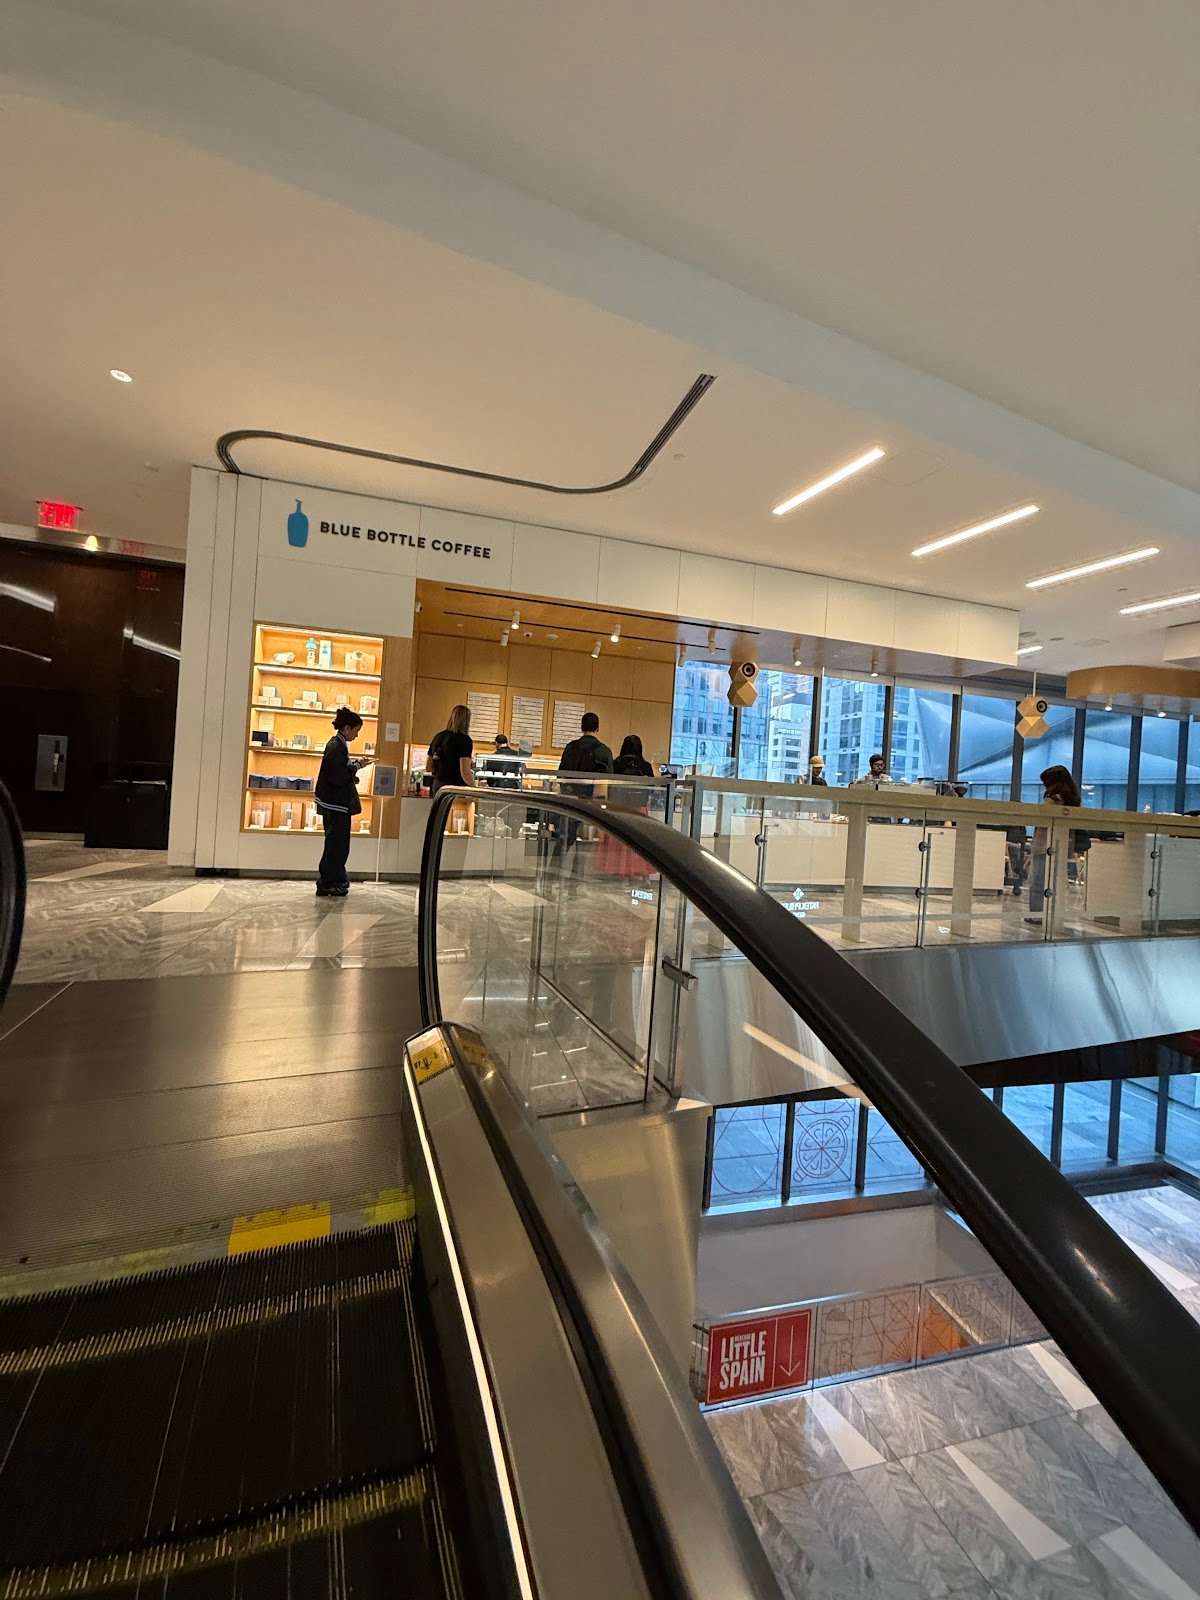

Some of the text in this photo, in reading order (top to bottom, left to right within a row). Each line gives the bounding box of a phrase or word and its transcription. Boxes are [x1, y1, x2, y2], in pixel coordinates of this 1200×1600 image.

[320, 520, 491, 559] BLUE BOTTLE COFFEE
[721, 1330, 767, 1363] LITTLE
[720, 1356, 766, 1390] SPAIN
